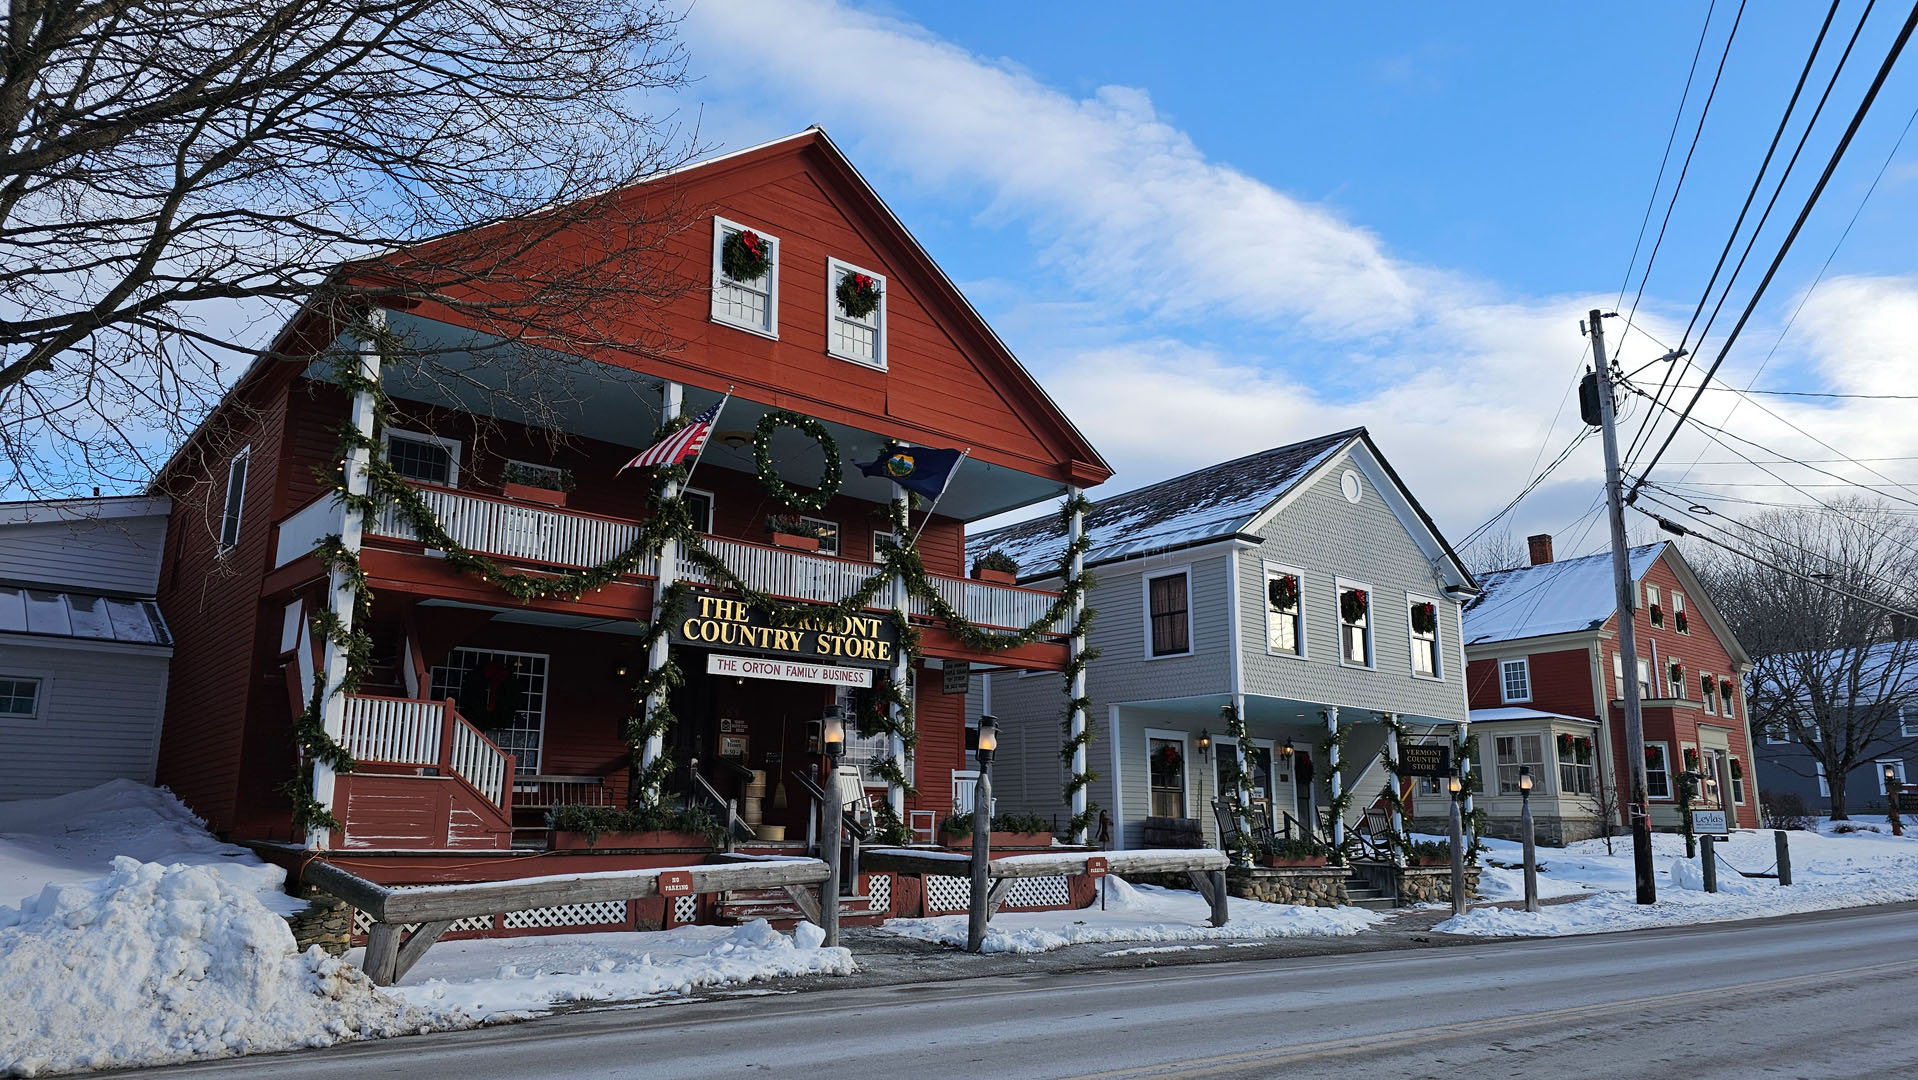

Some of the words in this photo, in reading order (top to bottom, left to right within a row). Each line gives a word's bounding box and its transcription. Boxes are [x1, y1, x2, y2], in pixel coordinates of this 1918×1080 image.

[698, 596, 750, 623] THE
[683, 618, 805, 652] COUNTRY
[817, 633, 891, 661] STORE
[717, 659, 737, 672] THE
[742, 661, 781, 676] ORTON
[786, 665, 818, 679] FAMILY
[823, 669, 864, 683] BUSINESS
[1406, 749, 1442, 757] VERMONT
[1407, 755, 1441, 764] COUNTRY
[1412, 763, 1437, 771] STORE
